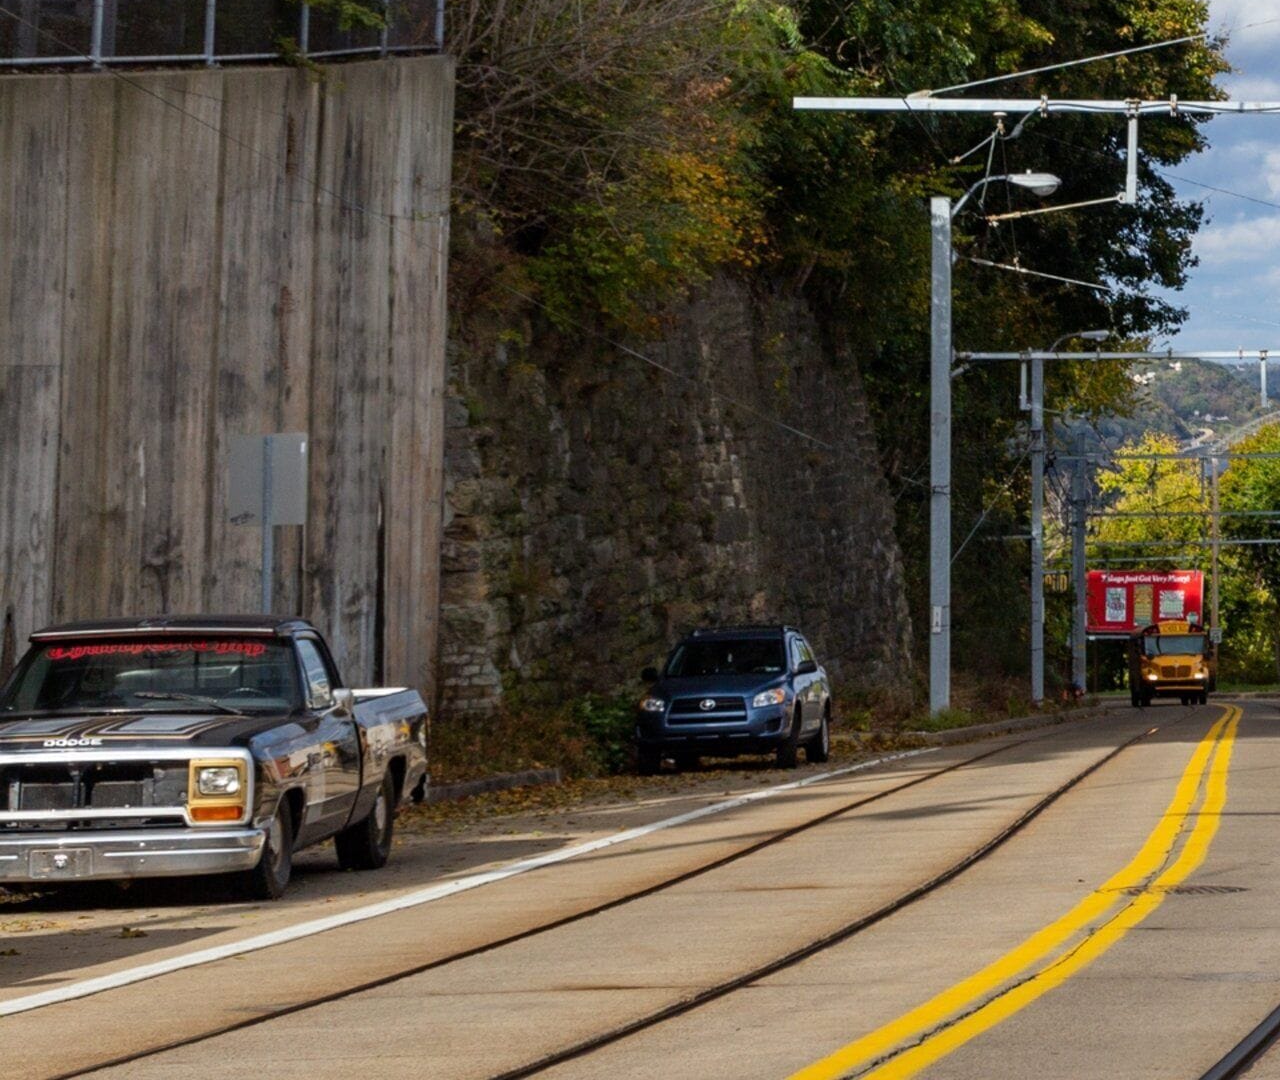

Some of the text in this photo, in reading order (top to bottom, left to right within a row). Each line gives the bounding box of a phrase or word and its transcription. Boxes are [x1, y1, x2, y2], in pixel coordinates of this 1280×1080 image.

[1138, 574, 1152, 583] Got
[1152, 574, 1166, 584] Very
[43, 739, 103, 748] DODGE
